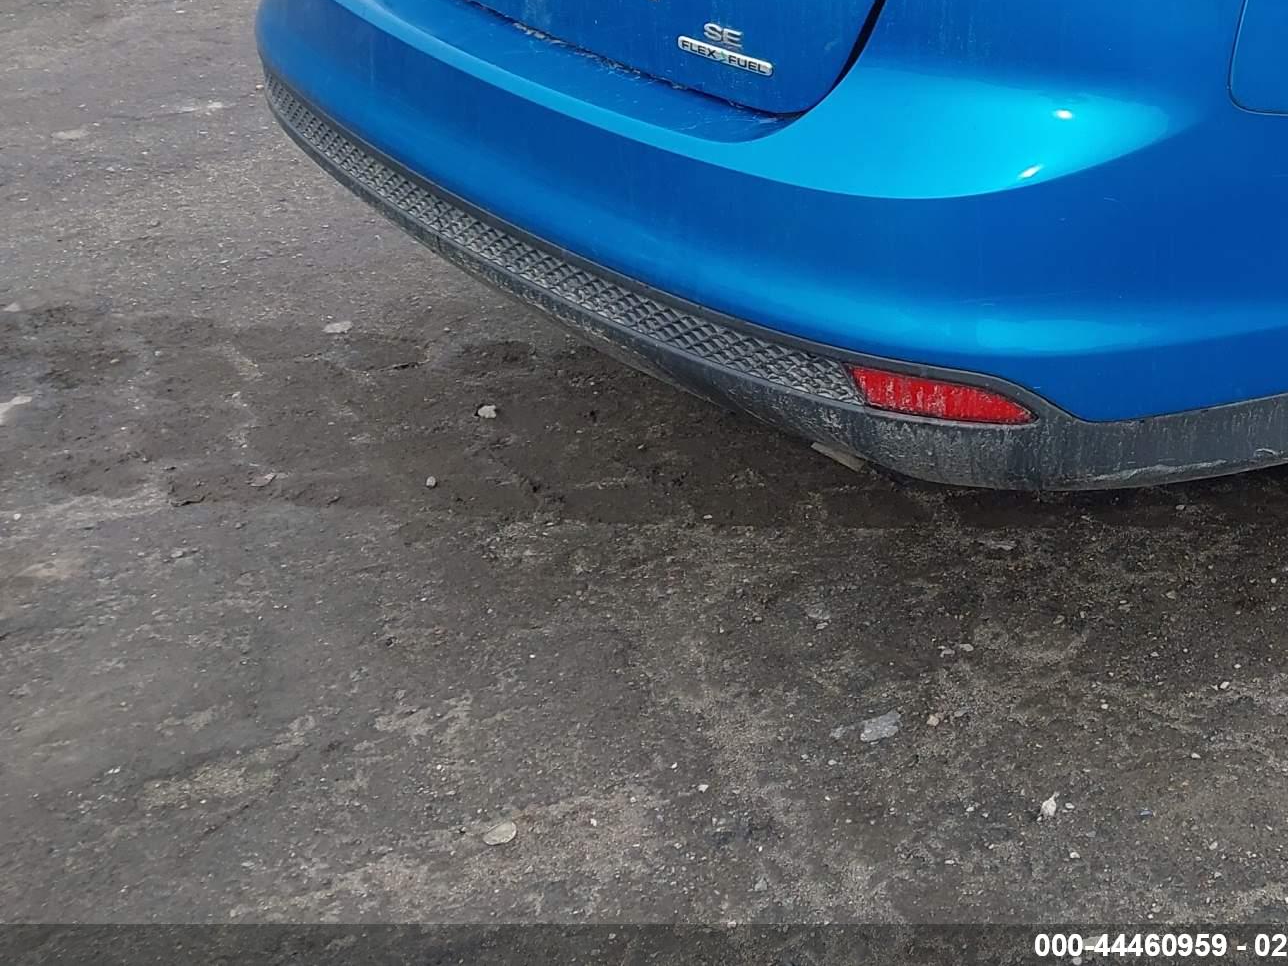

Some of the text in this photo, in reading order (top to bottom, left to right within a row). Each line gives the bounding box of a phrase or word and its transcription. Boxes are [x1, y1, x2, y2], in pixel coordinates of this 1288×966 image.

[703, 22, 744, 48] SE
[680, 39, 770, 74] FLEX FUEL
